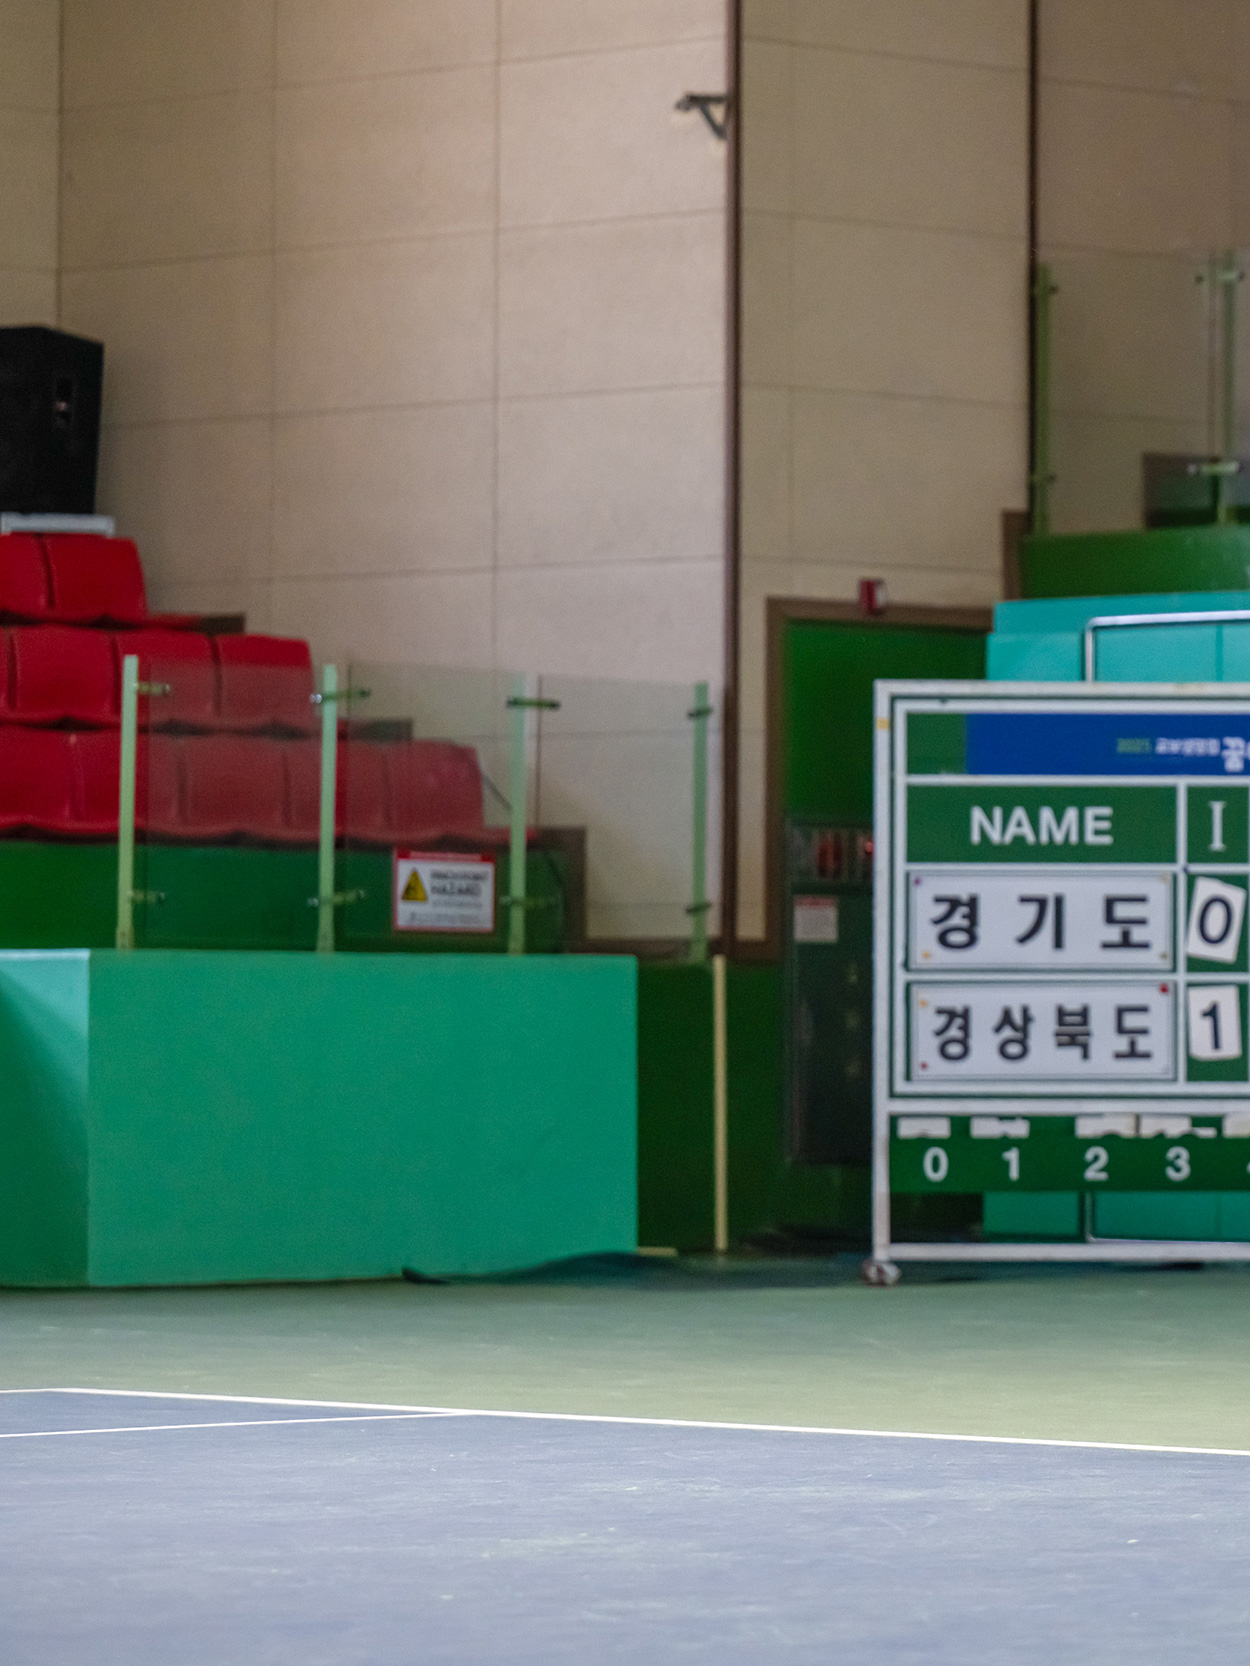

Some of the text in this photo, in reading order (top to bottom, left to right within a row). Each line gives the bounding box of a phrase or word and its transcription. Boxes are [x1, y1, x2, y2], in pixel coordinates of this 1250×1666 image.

[970, 806, 1114, 845] NAME
[931, 894, 1232, 949] 경기도 0
[933, 1002, 1221, 1061] 경상북도 1
[923, 1147, 949, 1181] 0
[1002, 1147, 1020, 1181] 1
[1084, 1147, 1109, 1181] 2
[1165, 1147, 1191, 1181] 3
